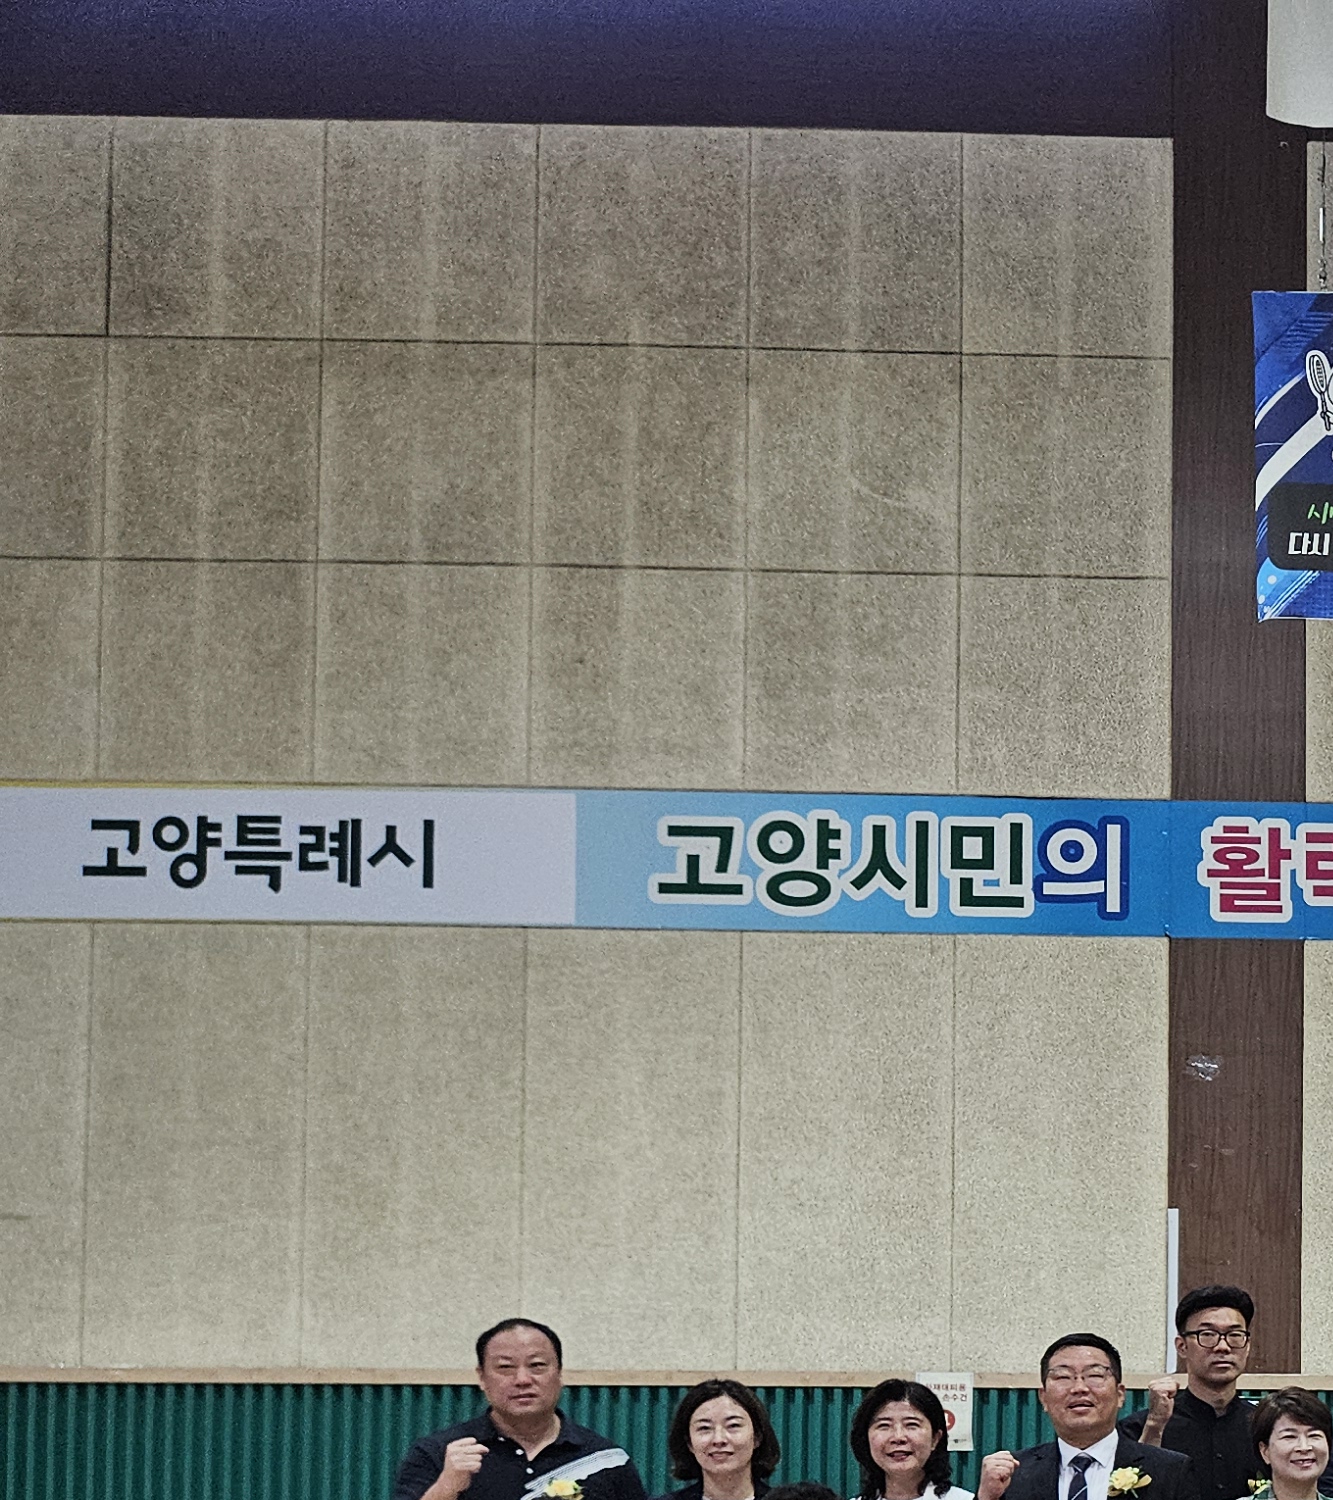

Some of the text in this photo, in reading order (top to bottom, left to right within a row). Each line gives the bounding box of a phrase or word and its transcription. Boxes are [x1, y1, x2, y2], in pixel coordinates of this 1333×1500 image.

[1287, 531, 1330, 556] 다시
[81, 814, 436, 895] 고양특례시
[655, 815, 1124, 915] 고양시민의
